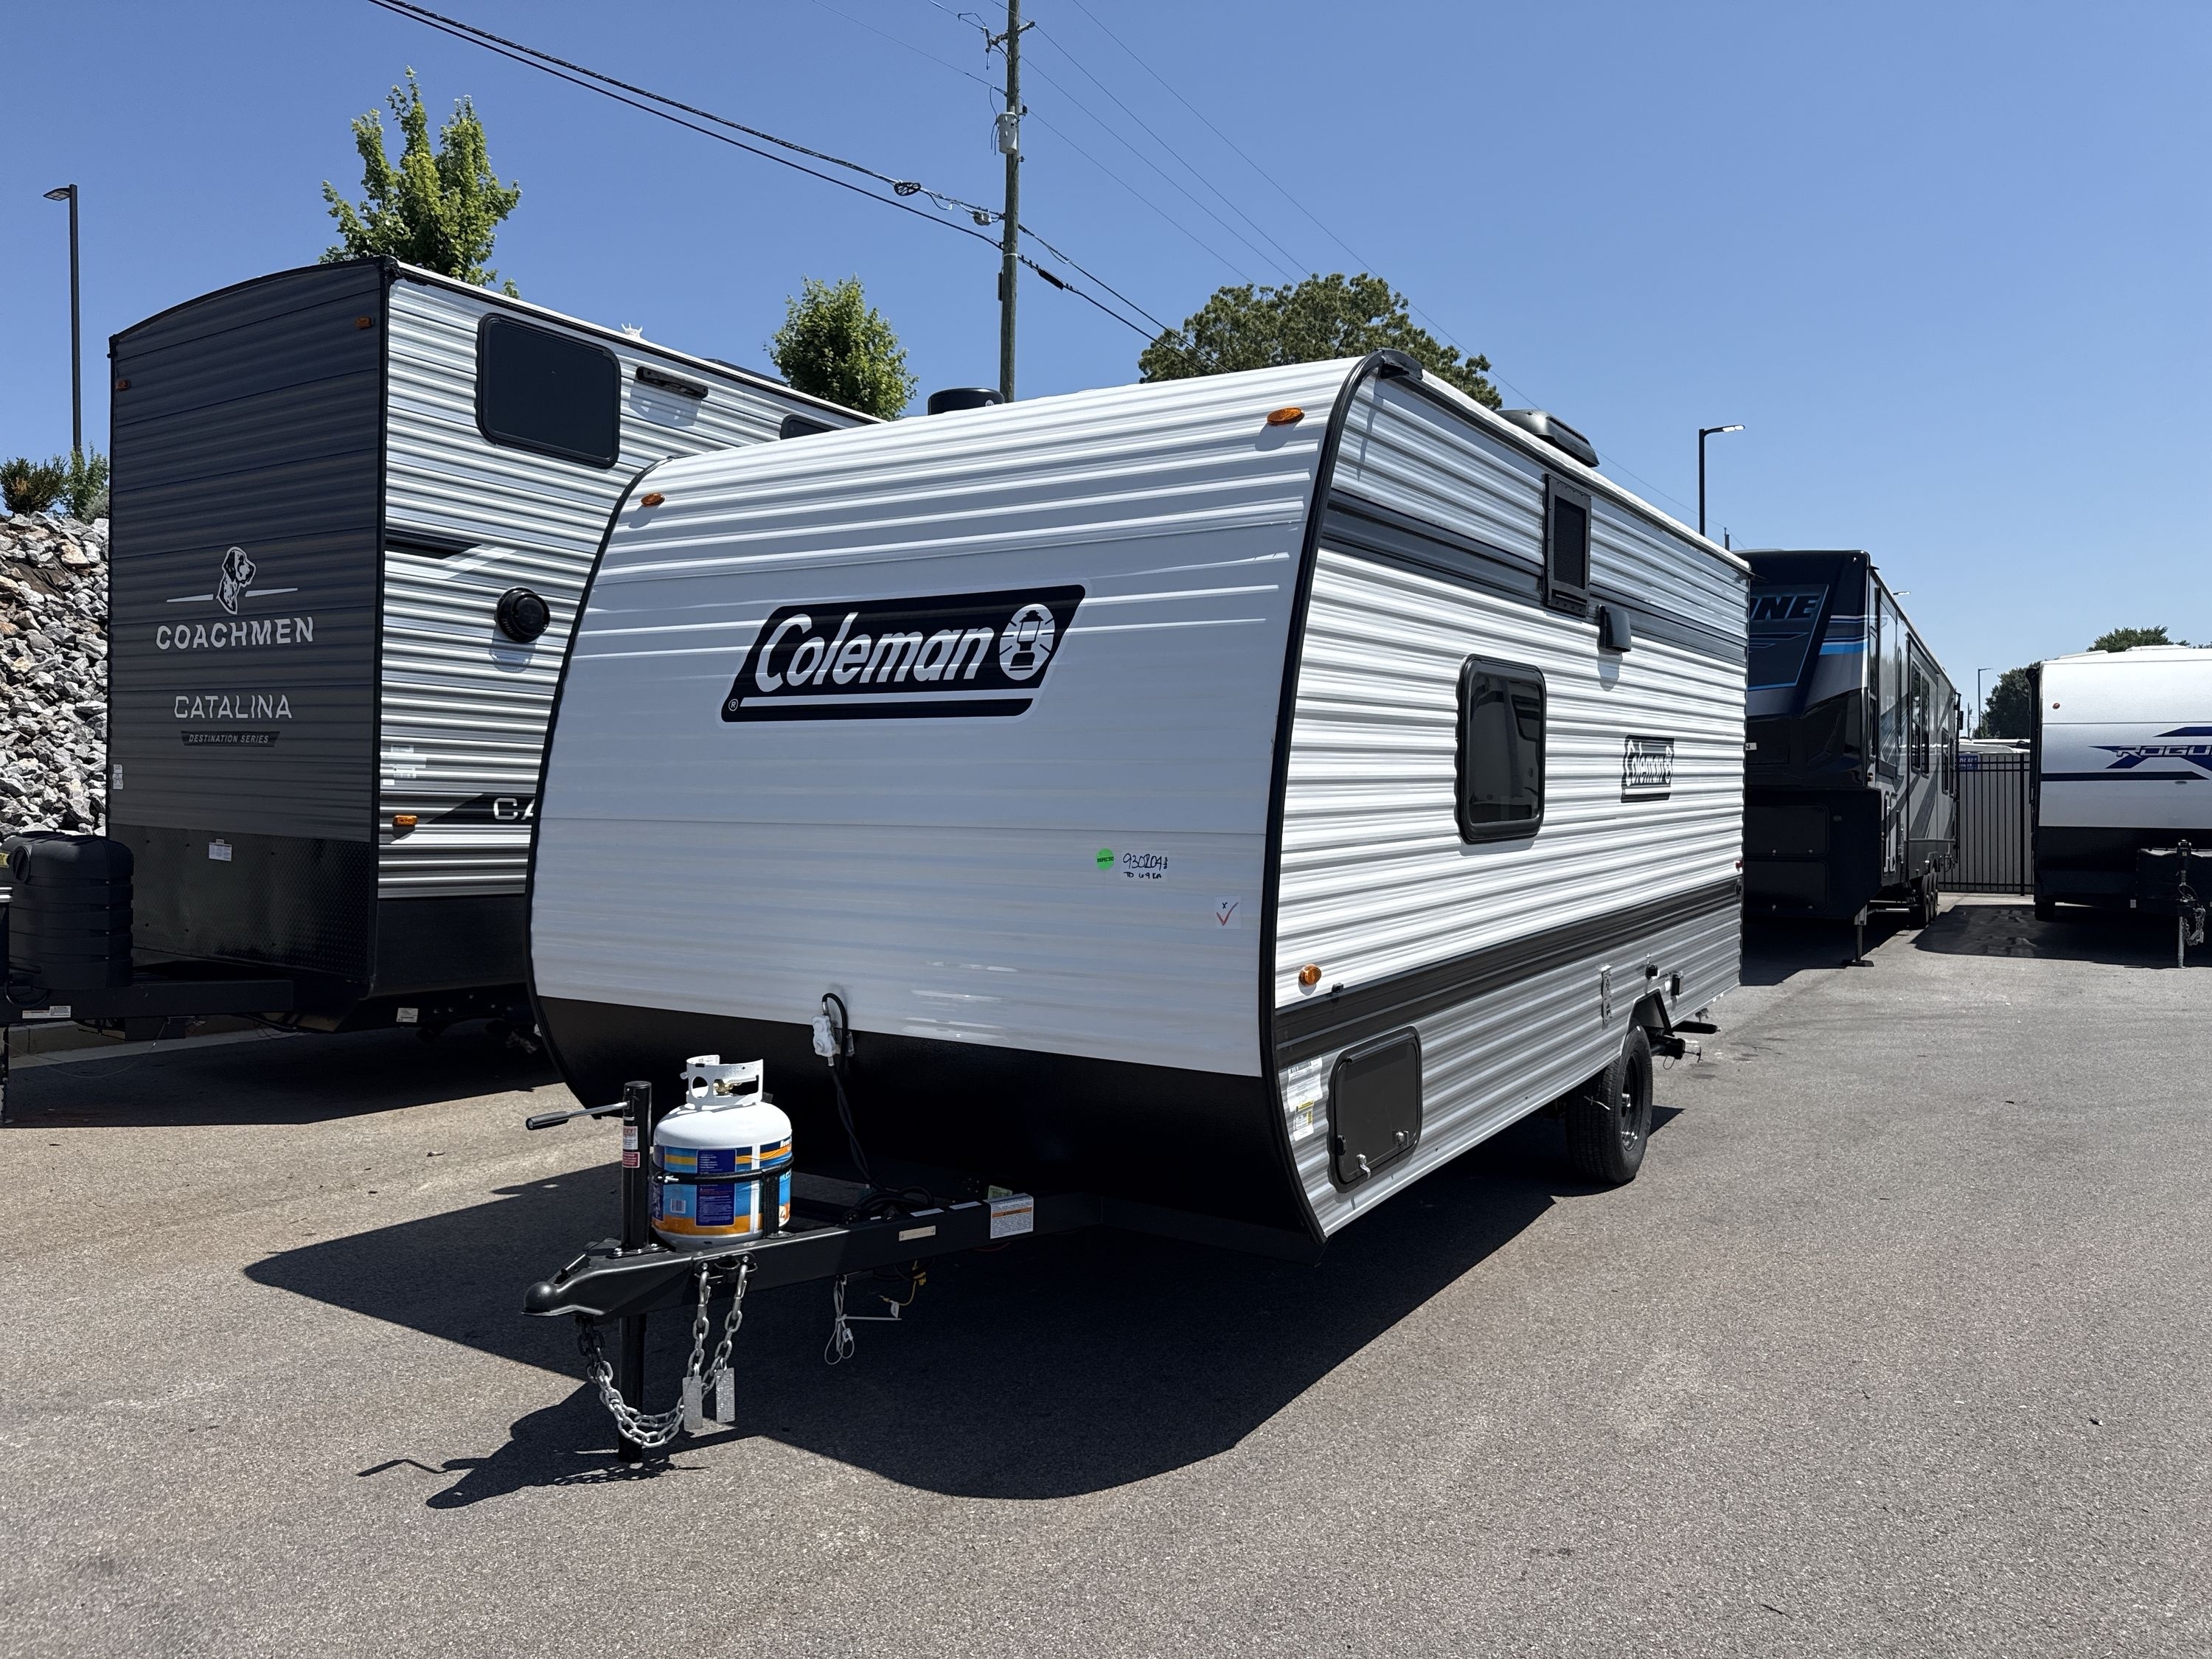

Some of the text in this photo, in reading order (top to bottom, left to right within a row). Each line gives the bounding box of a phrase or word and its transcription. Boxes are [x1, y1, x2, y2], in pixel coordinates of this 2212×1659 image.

[156, 616, 313, 650] COACHMEN
[754, 612, 994, 692] Coleman
[174, 695, 293, 719] CATALINA
[189, 734, 269, 743] DESTINATION SERIES
[2112, 745, 2212, 758] ROGU
[1624, 740, 1665, 787] Coleman
